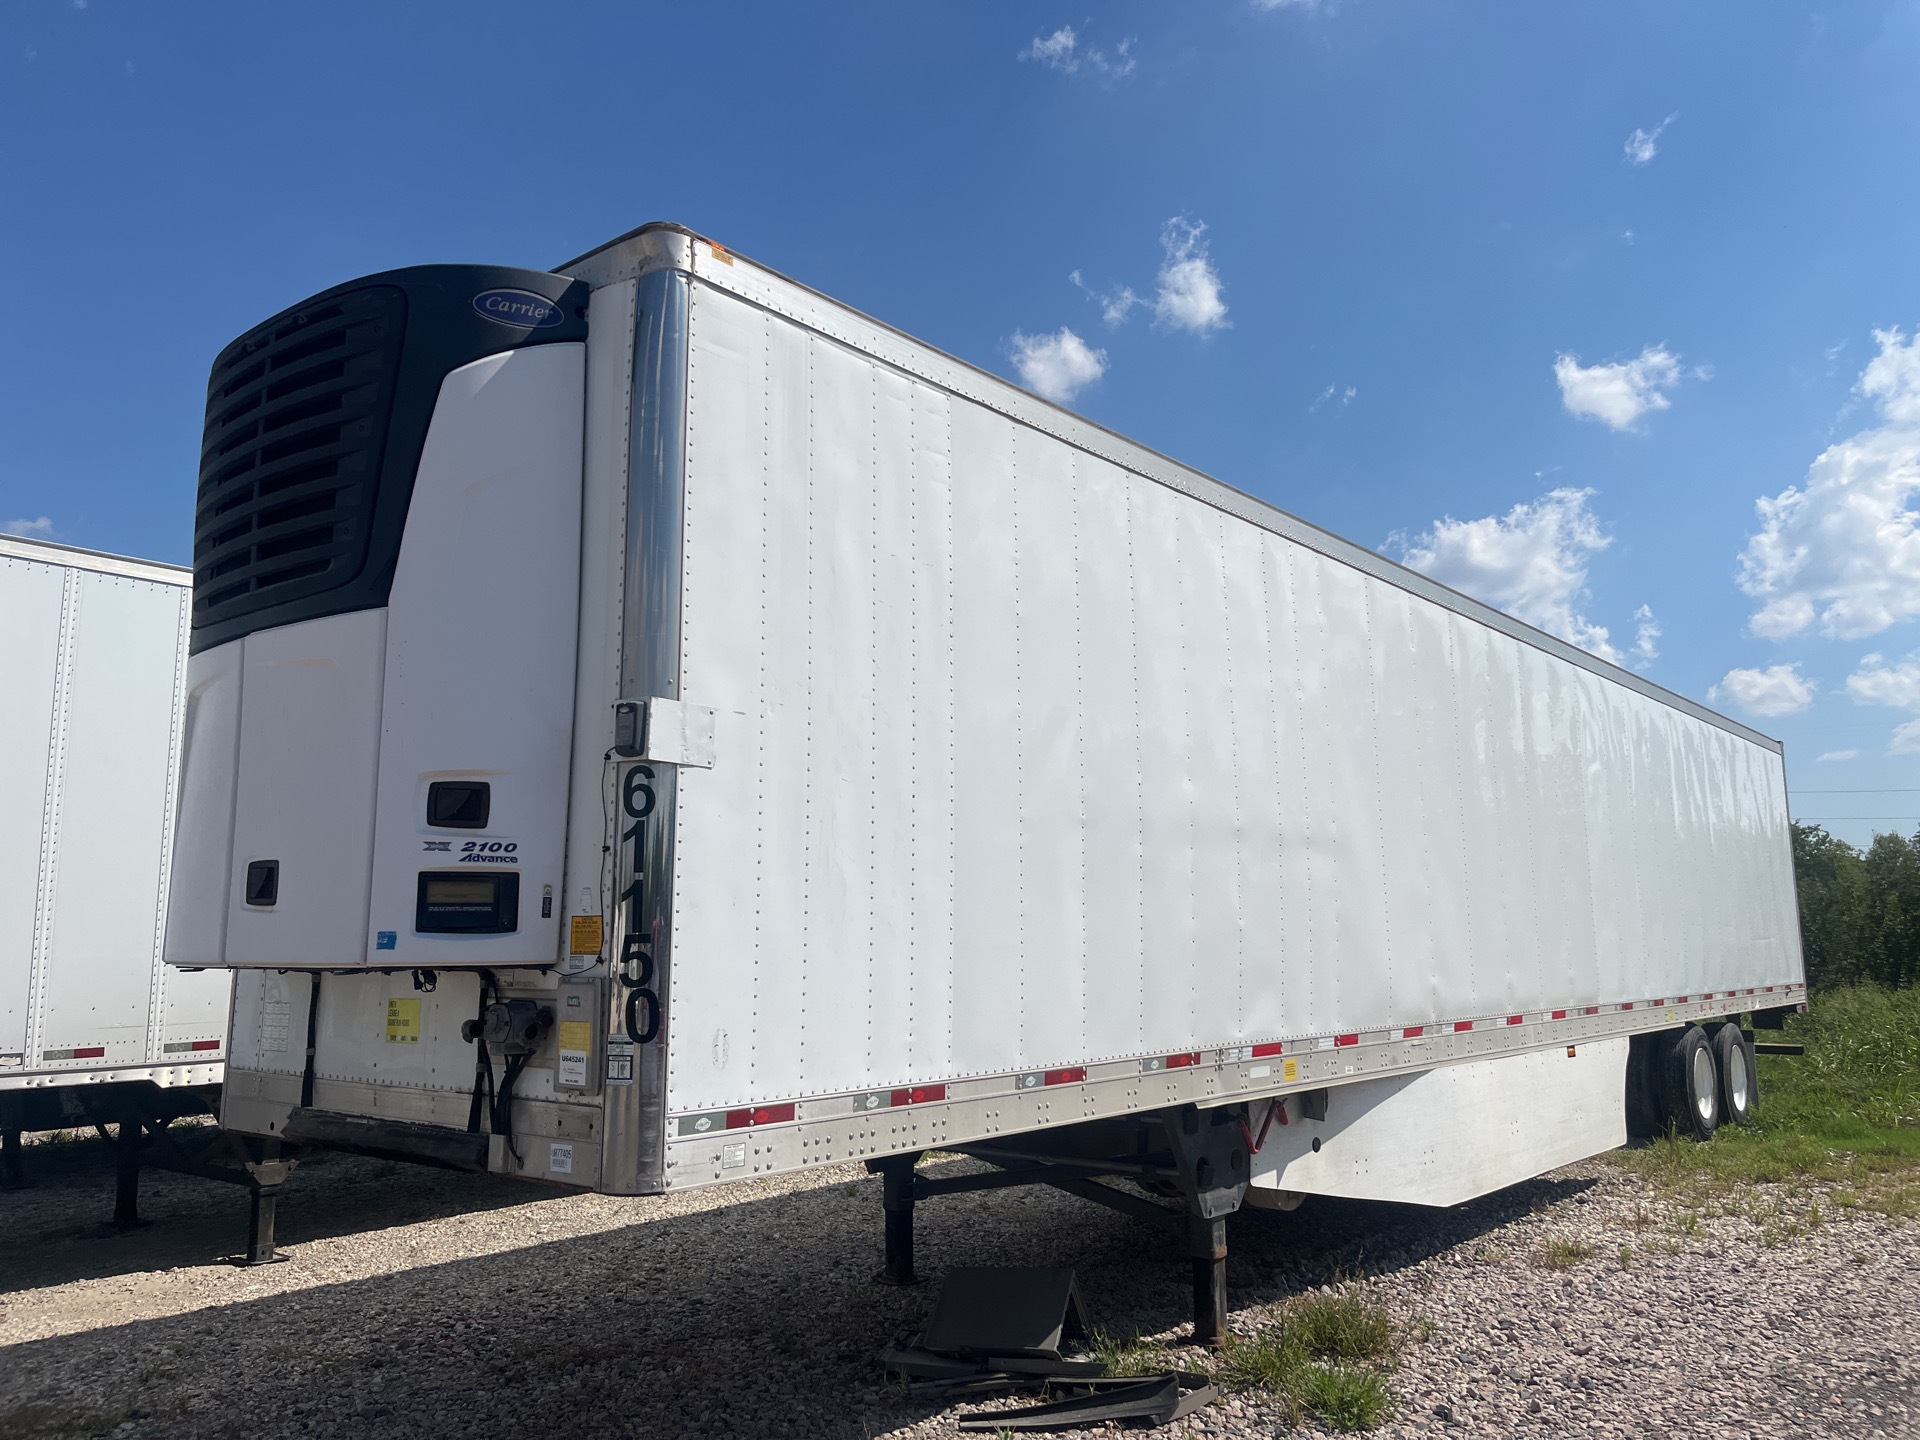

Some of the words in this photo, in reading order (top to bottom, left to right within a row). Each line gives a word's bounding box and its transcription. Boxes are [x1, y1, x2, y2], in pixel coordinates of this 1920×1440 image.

[485, 296, 553, 319] Carrier
[460, 841, 518, 853] 2100
[458, 852, 518, 864] Advance
[619, 765, 660, 1044] 61150
[561, 1054, 585, 1064] U645241
